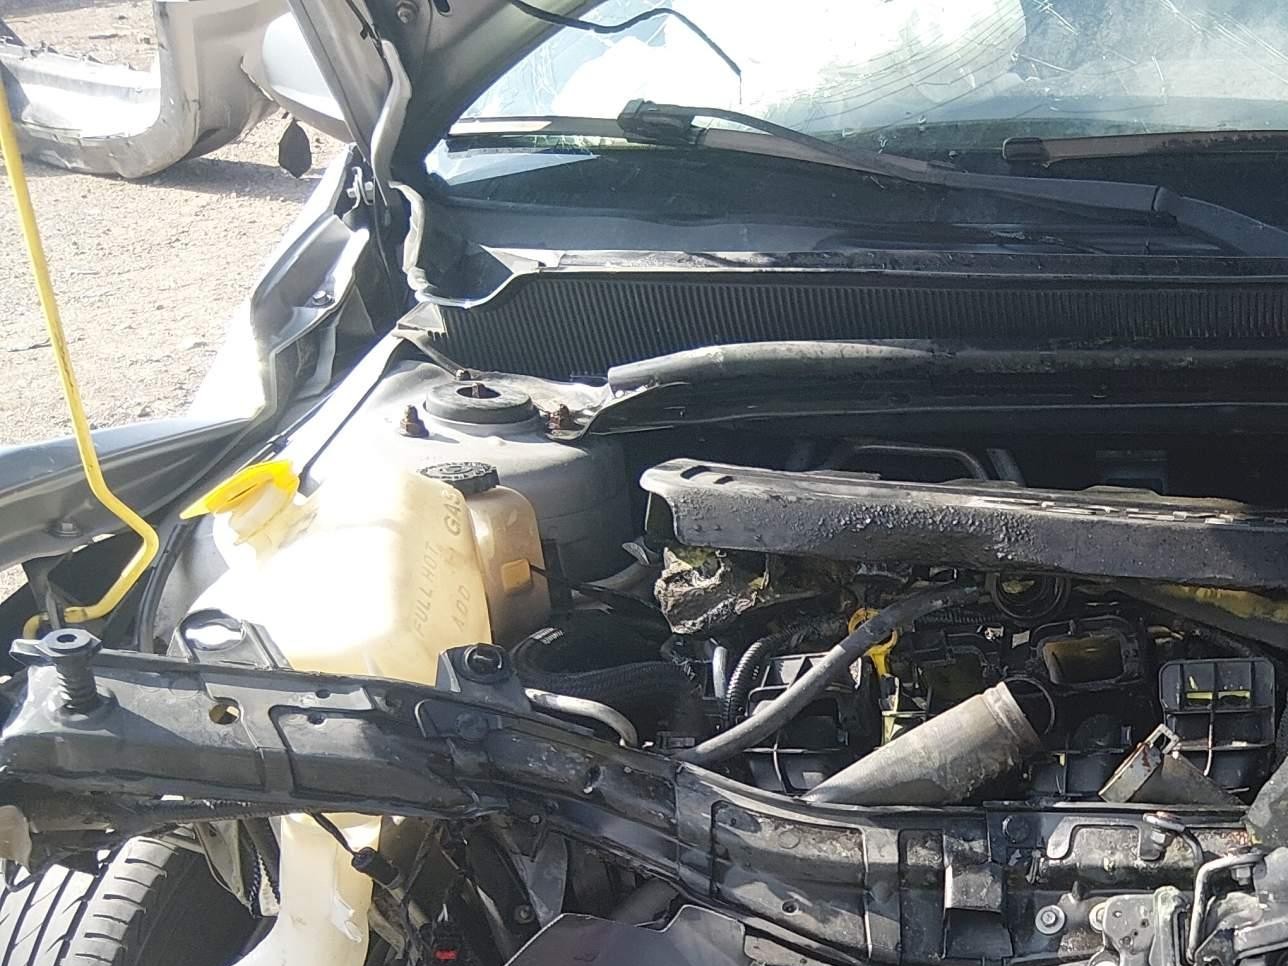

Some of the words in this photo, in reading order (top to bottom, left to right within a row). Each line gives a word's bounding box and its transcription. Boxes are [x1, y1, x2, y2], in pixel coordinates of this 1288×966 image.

[421, 541, 441, 584] HOT
[413, 586, 433, 638] FULL
[451, 584, 471, 631] ADD
